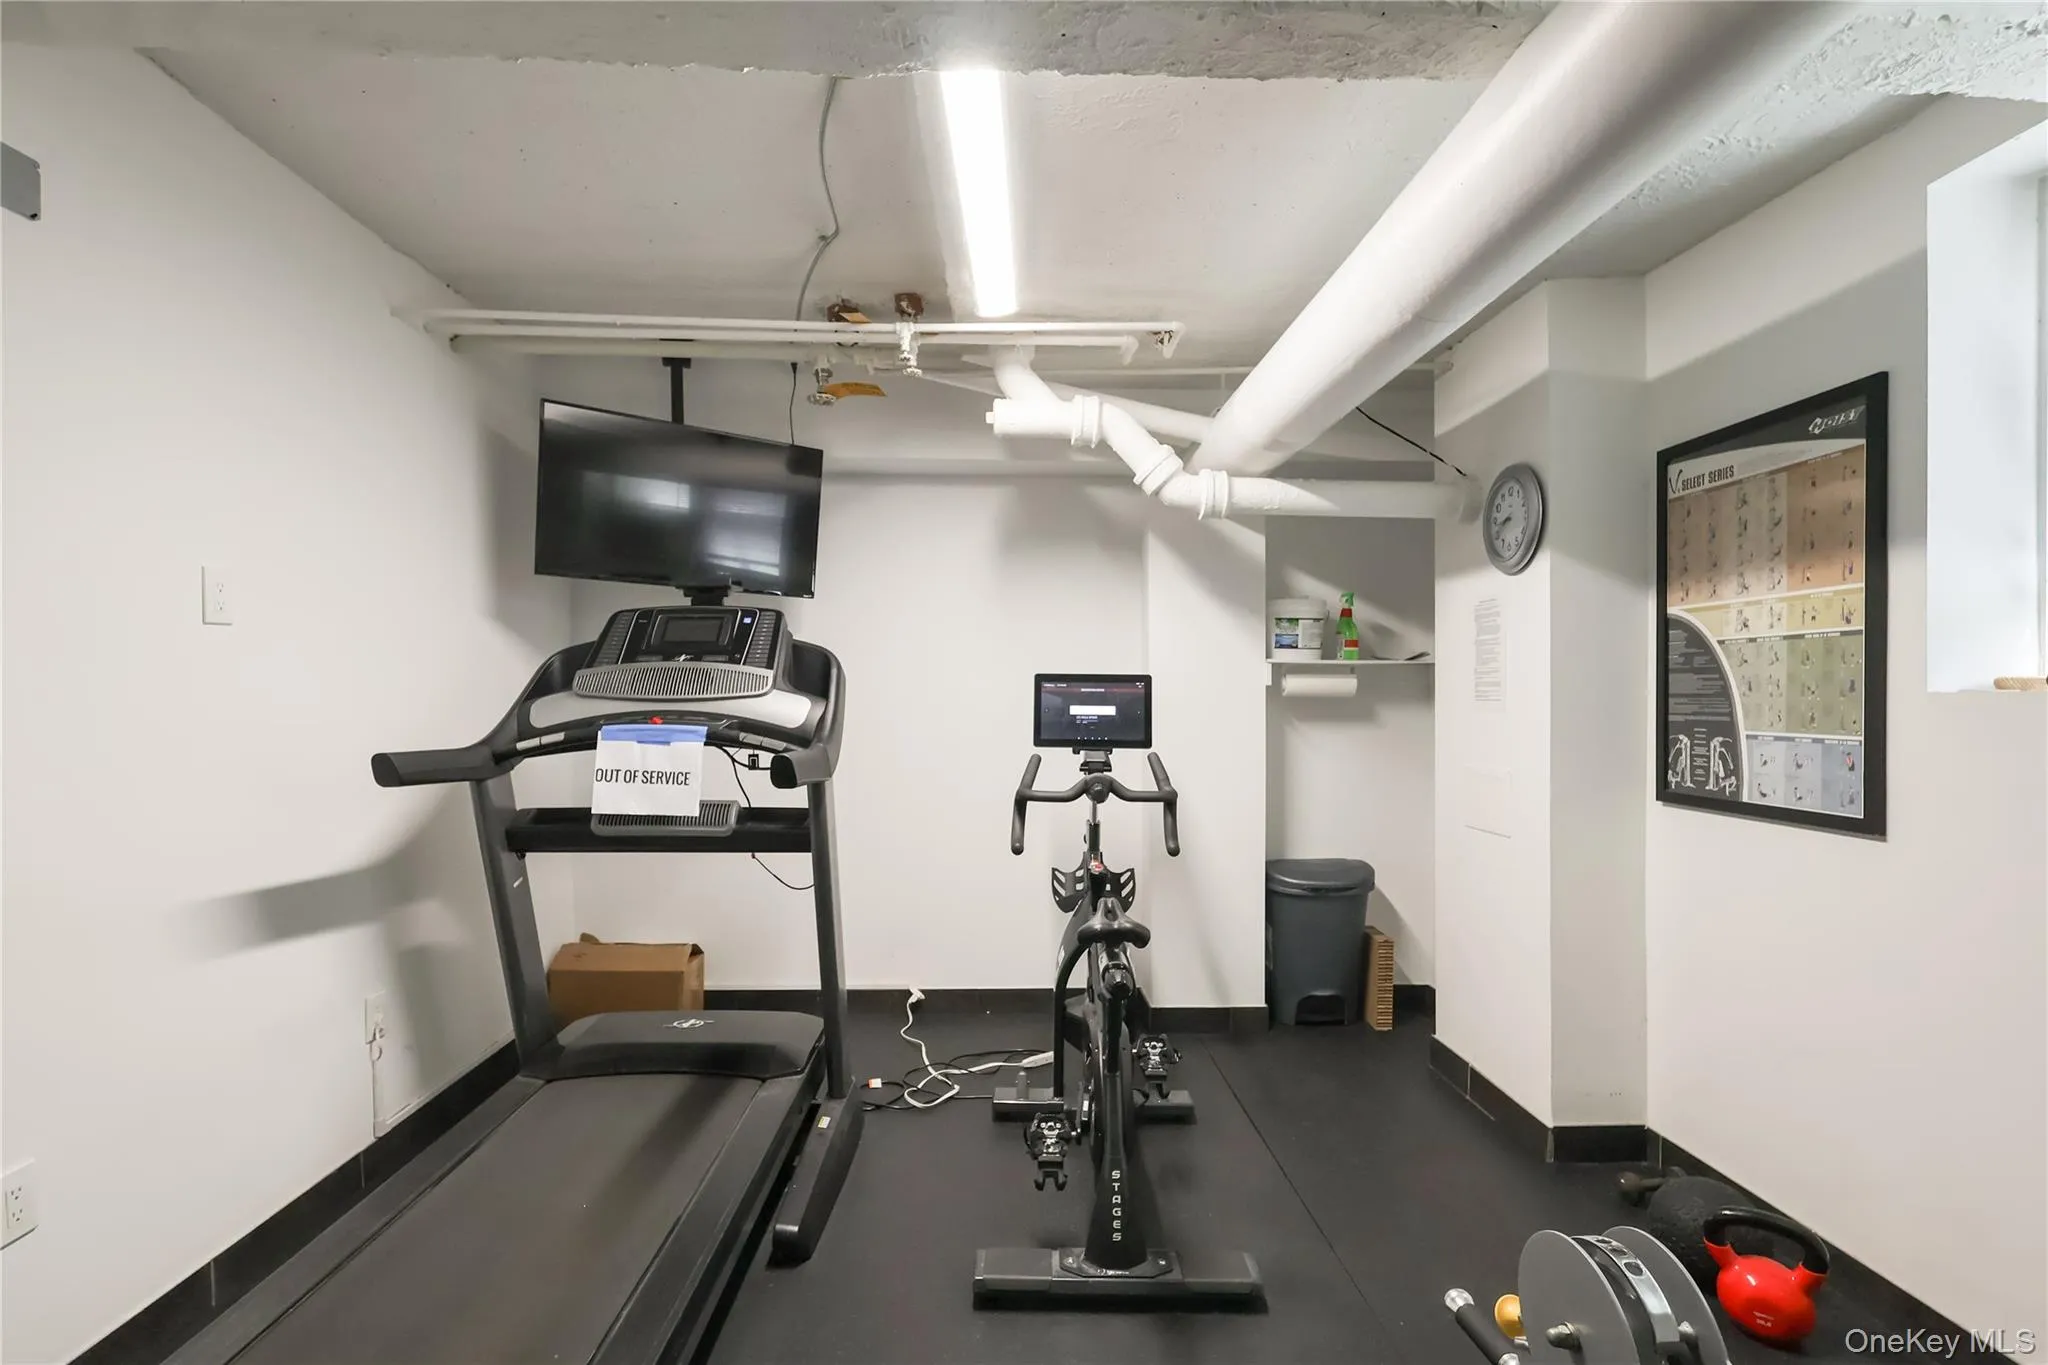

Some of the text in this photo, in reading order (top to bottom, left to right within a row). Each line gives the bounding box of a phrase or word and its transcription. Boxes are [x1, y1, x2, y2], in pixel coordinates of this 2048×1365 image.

[1681, 473, 1705, 491] SELECT
[1708, 465, 1735, 484] SERIES
[595, 768, 691, 786] OUT OF SERVICE
[1111, 1170, 1122, 1242] STAGES
